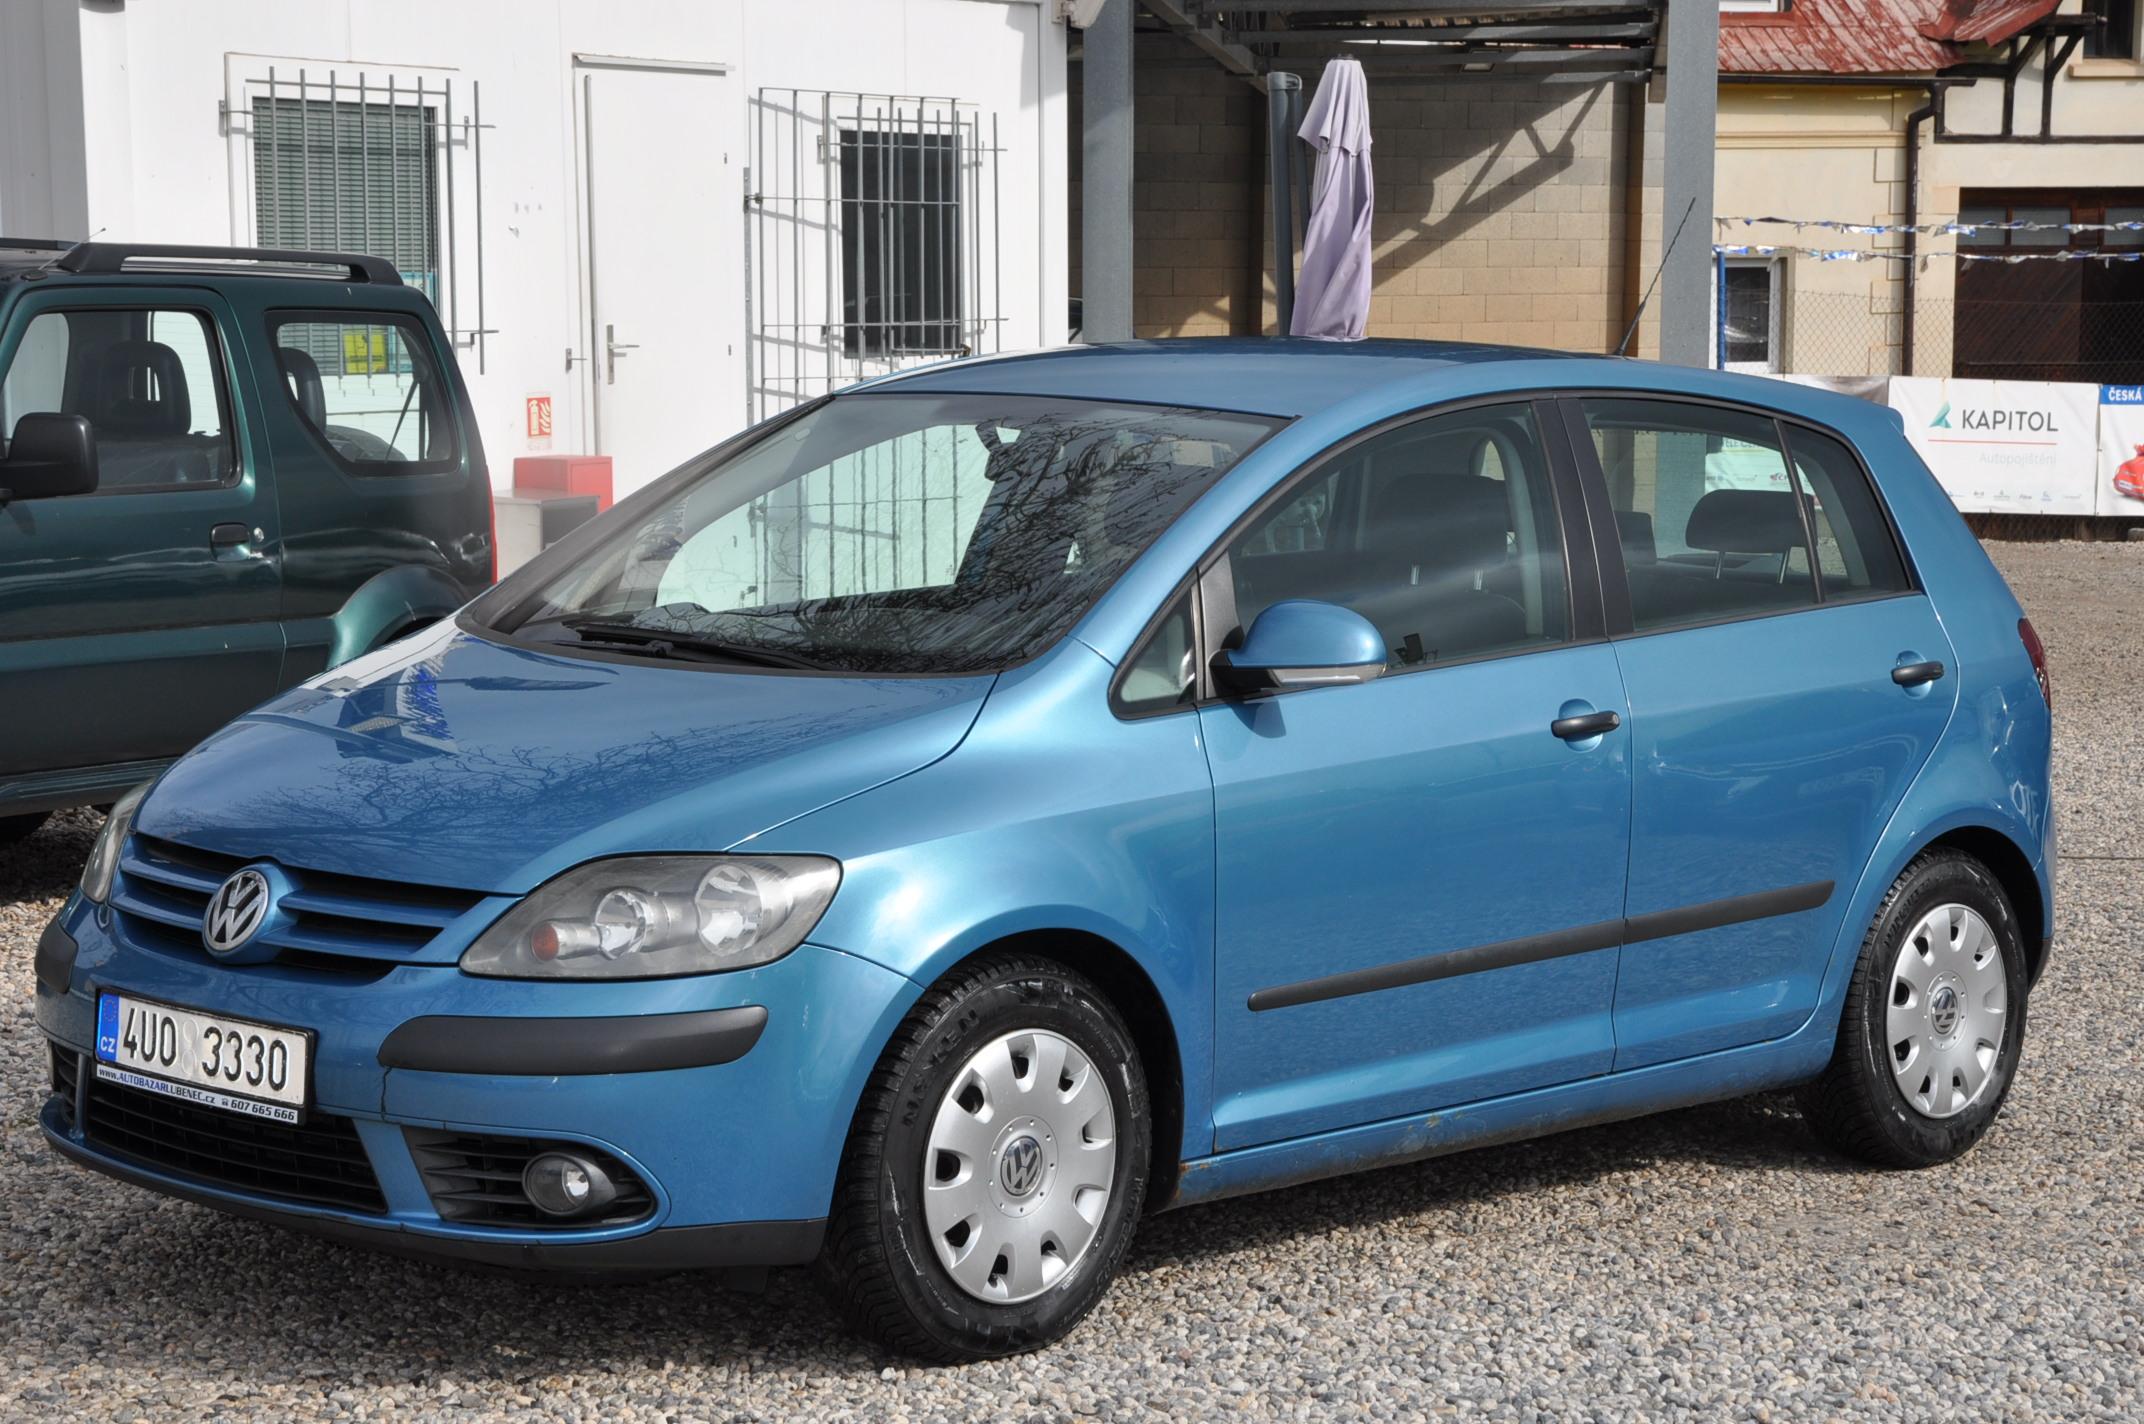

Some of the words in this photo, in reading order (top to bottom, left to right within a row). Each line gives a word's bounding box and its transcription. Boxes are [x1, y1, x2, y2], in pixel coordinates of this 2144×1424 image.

[2107, 387, 2142, 401] ČESKÁ
[1962, 409, 2058, 432] KAPITOL
[100, 1036, 116, 1053] CZ
[202, 1026, 288, 1092] 3330
[230, 1100, 251, 1111] 607
[251, 1104, 272, 1116] 665
[273, 1108, 295, 1121] 666
